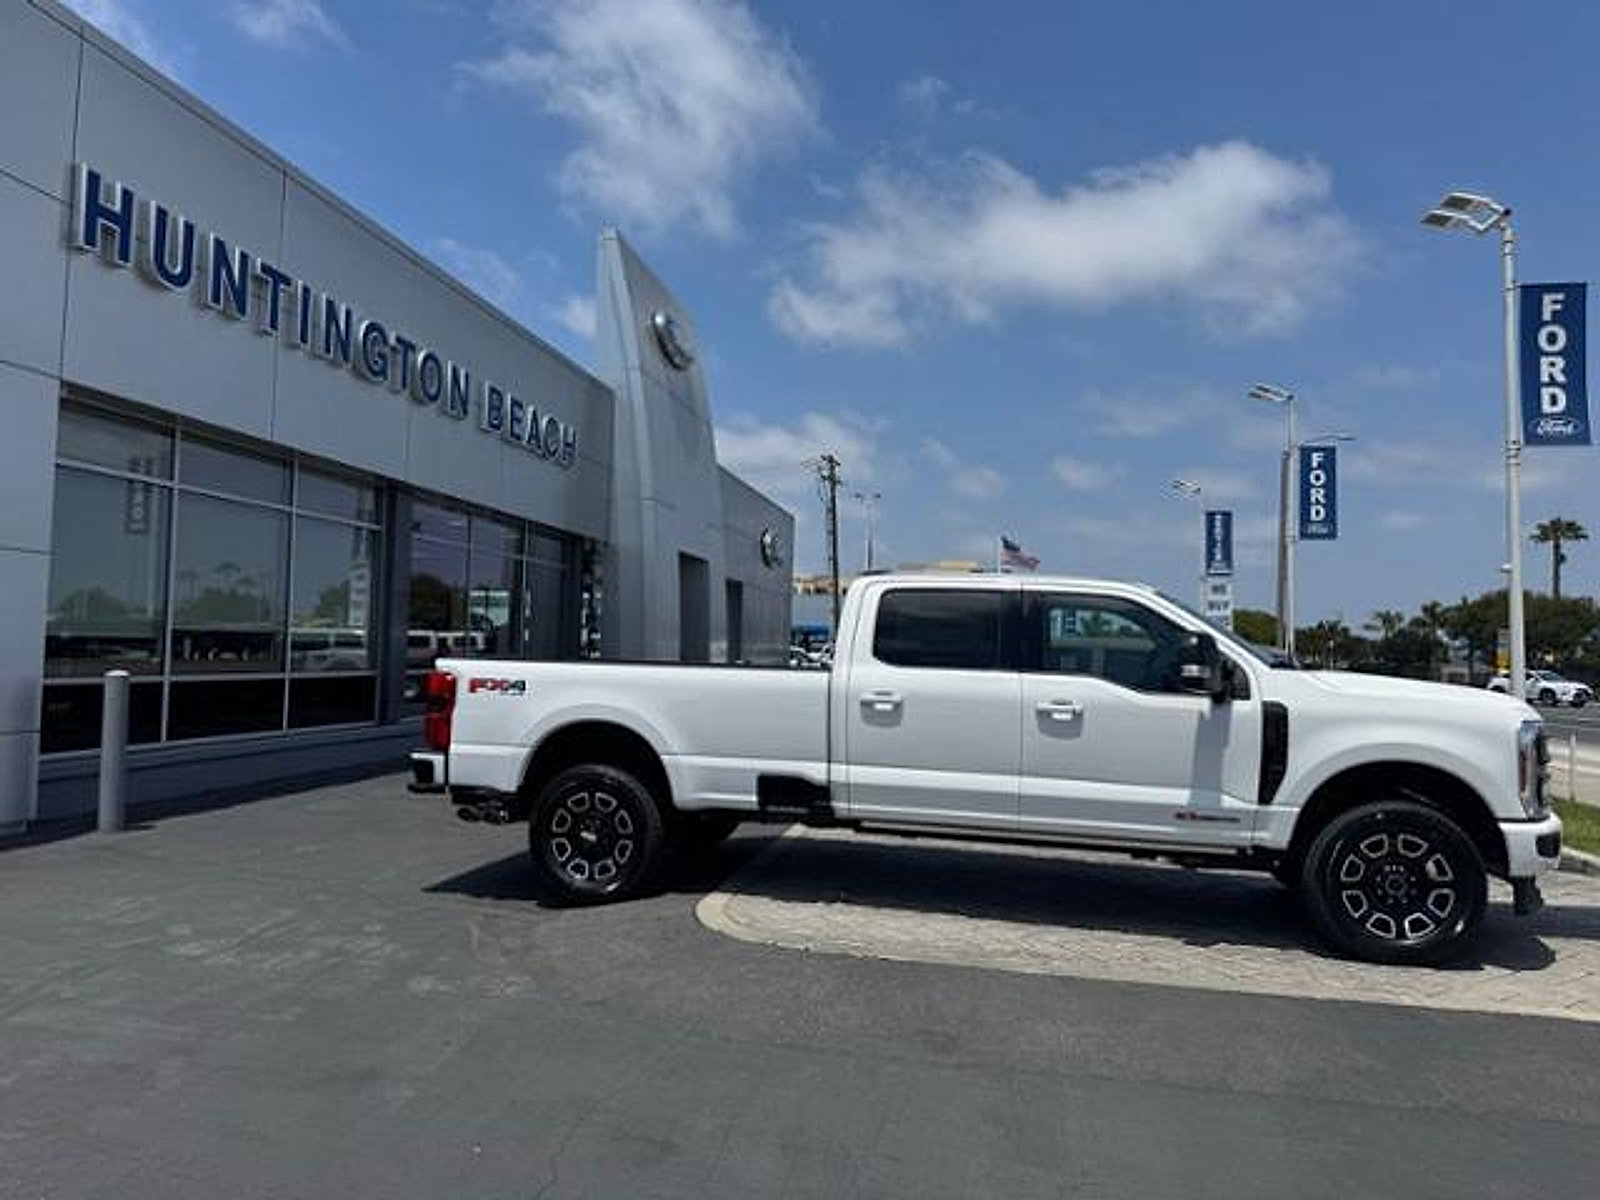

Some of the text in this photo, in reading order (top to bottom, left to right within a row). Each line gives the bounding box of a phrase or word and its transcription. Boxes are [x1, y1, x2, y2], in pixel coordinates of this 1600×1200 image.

[80, 163, 577, 468] HUNTINGTON BEACH
[1537, 292, 1567, 415] FORD
[1310, 452, 1326, 521] FORD
